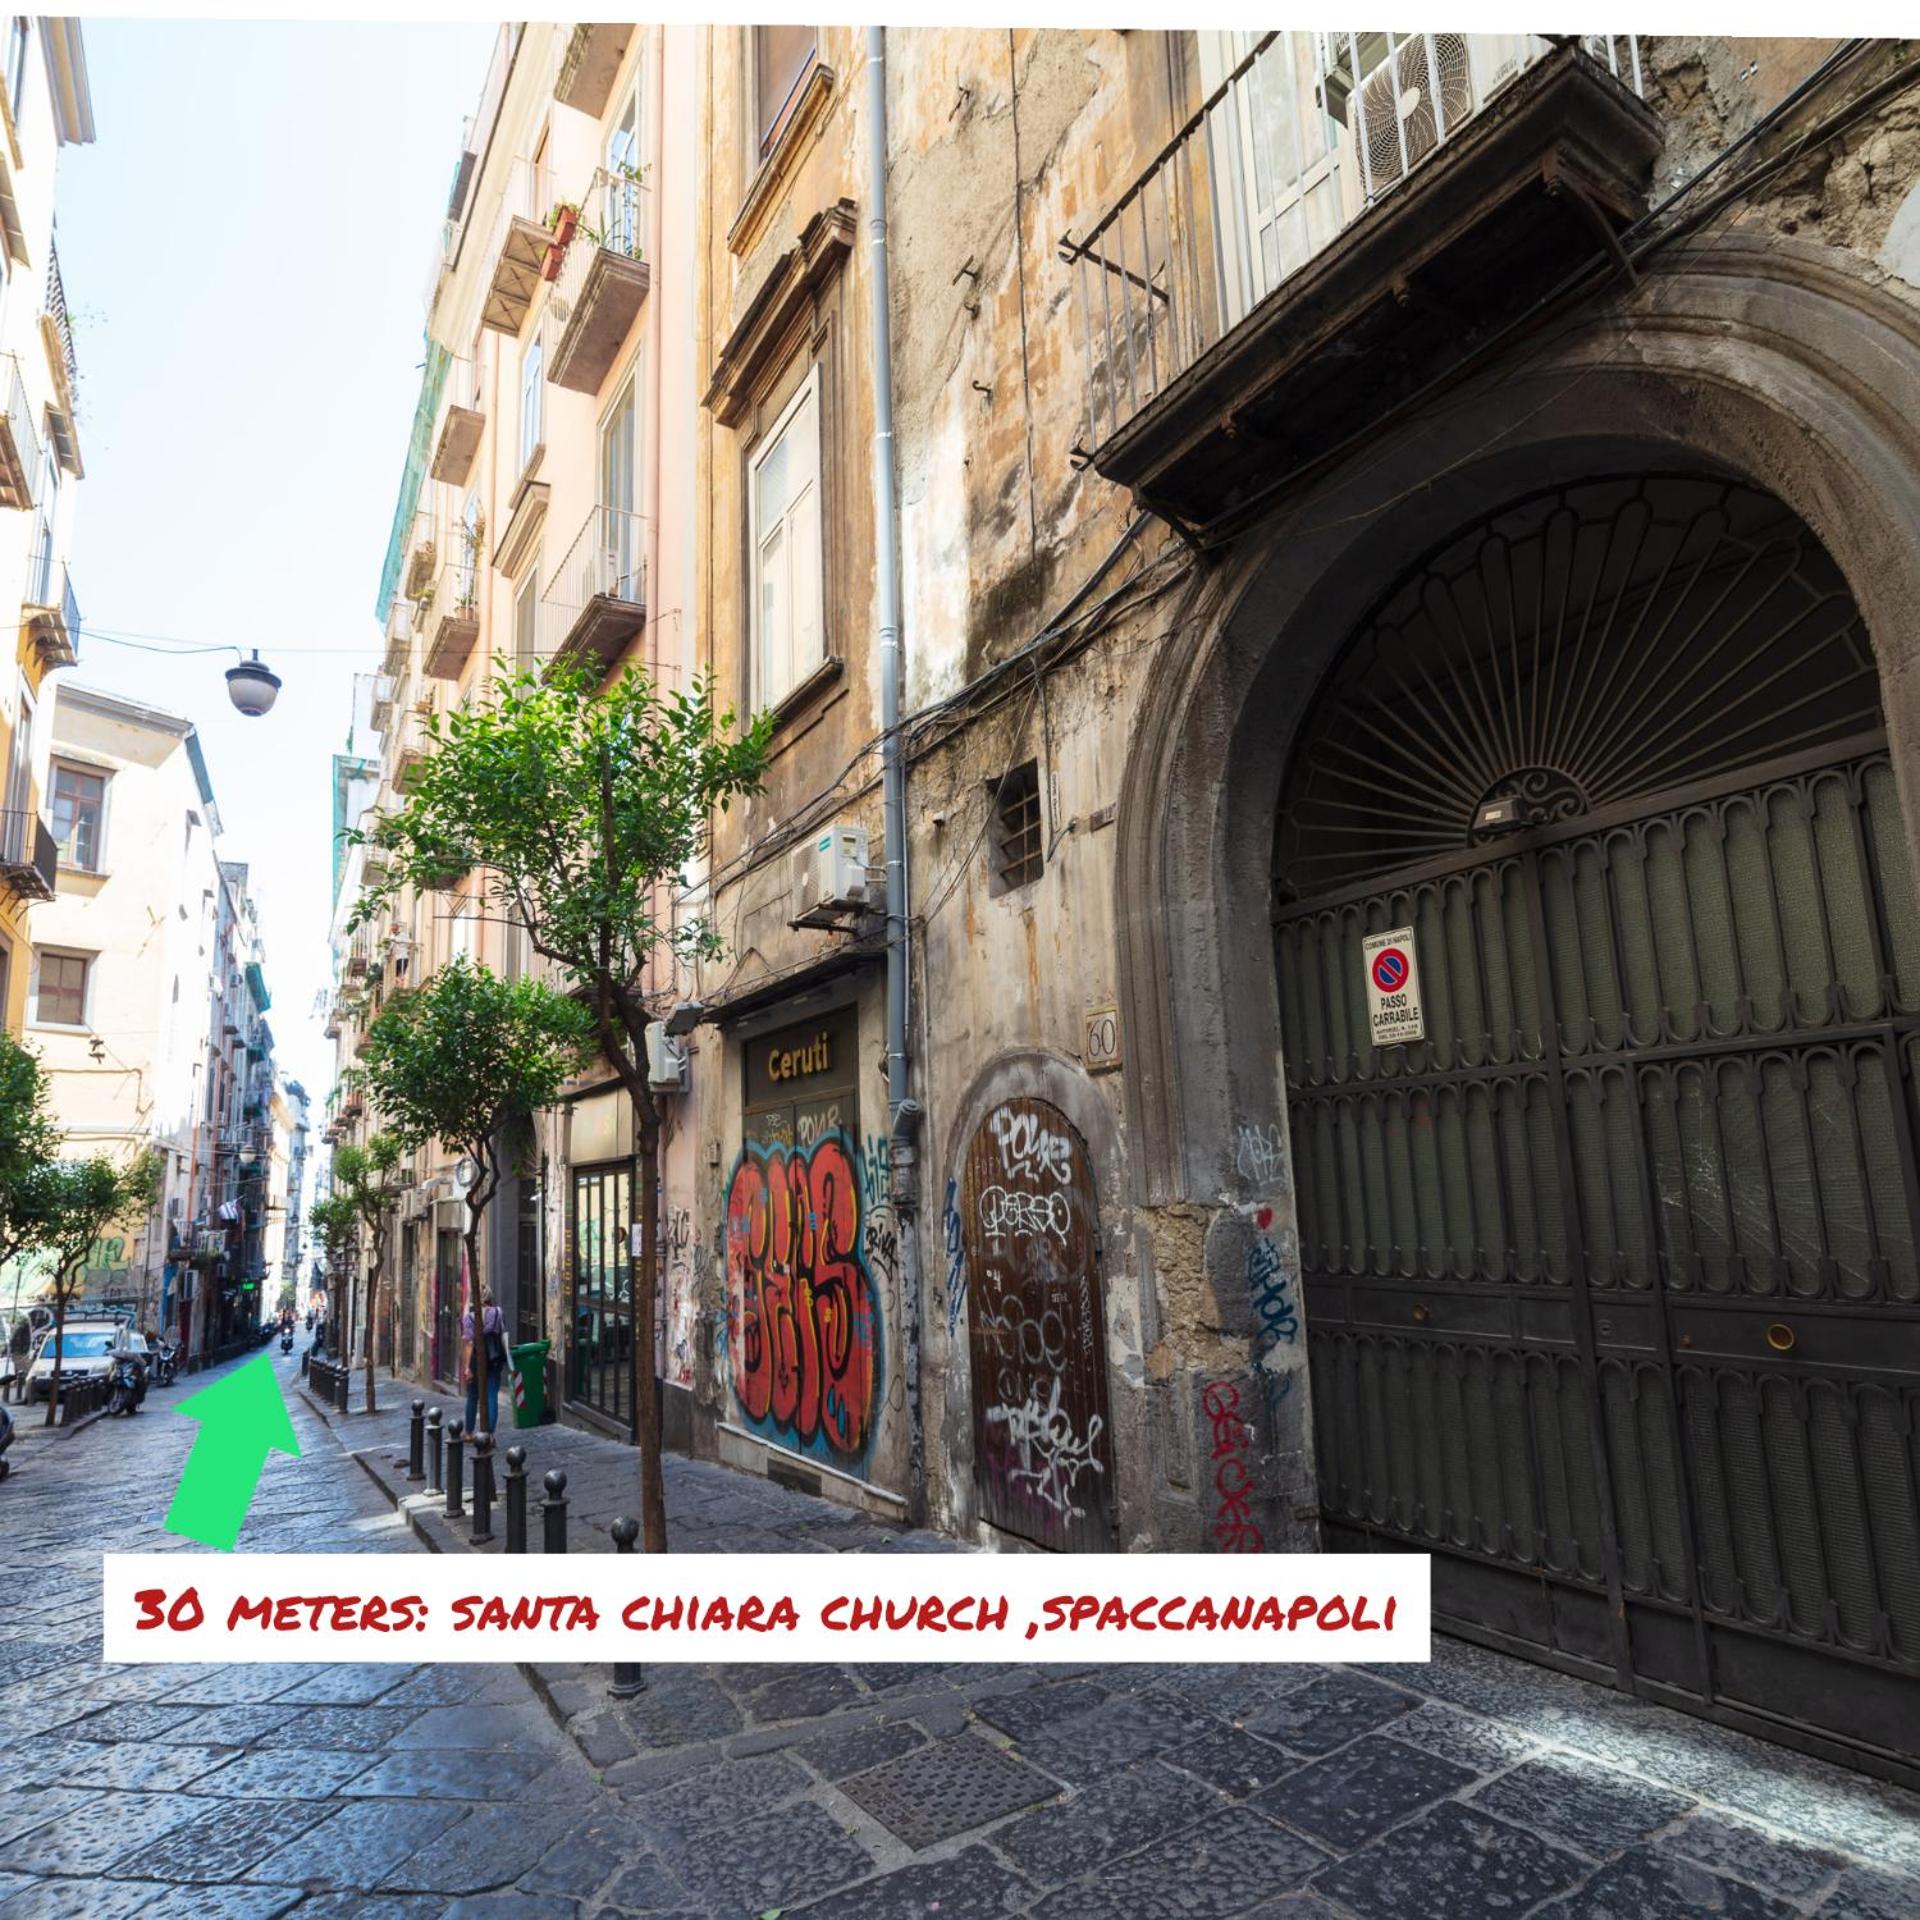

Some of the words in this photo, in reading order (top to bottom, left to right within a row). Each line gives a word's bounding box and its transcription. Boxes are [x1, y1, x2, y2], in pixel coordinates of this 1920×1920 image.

[1380, 994, 1407, 1010] PASSO
[1373, 1007, 1419, 1027] CARRABILE
[1089, 1019, 1115, 1056] 60
[769, 1031, 829, 1081] Ceruti
